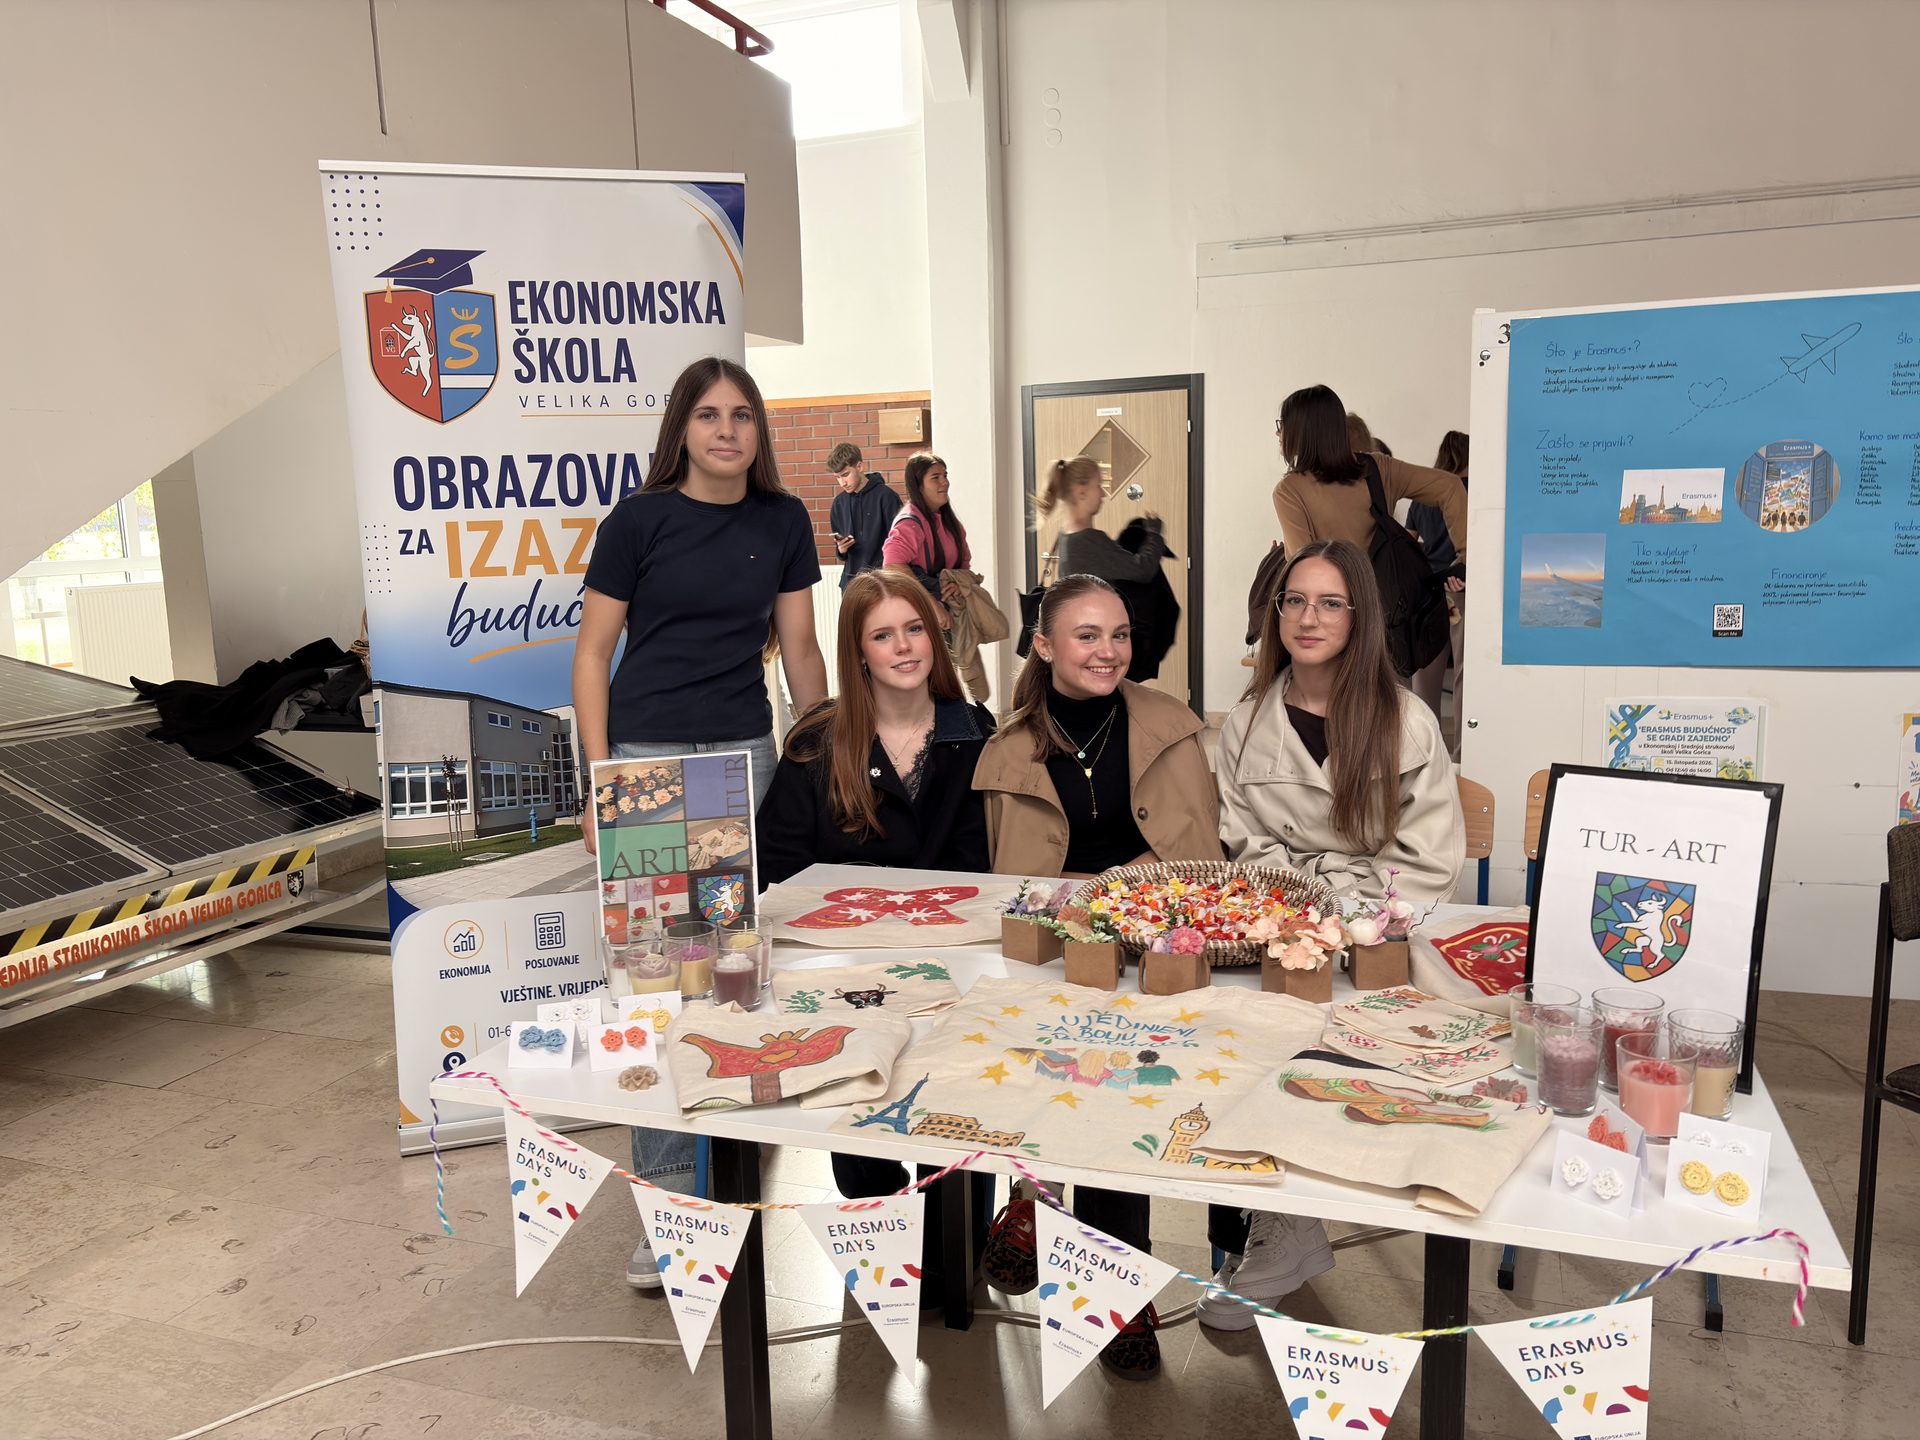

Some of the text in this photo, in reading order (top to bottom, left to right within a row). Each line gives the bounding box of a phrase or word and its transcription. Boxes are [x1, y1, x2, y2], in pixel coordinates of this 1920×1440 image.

[508, 281, 726, 325] EKONOMSKA
[512, 328, 637, 384] ŠKOLA
[518, 395, 610, 408] VELIKA
[1535, 429, 1575, 450] Zašto
[393, 453, 656, 511] OBRAZOVA
[398, 529, 435, 556] ZA
[1673, 713, 1714, 721] Erasmus+
[1683, 725, 1737, 734] BUDUĆNOST
[1646, 734, 1658, 742] SE
[1659, 734, 1686, 742] GRADI
[725, 755, 749, 817] TUR
[1579, 827, 1640, 855] TUR
[1661, 839, 1727, 865] ART
[601, 846, 689, 882] ART
[53, 925, 141, 971] STRUKOVNA
[144, 914, 188, 941] ŠKOLA
[190, 895, 233, 926] VELIKA
[236, 880, 282, 911] GORICA
[439, 964, 491, 980] EKONOMIJA
[525, 955, 580, 970] POSLOVANJE
[500, 985, 556, 1004] VJEŠTINE.
[516, 1153, 553, 1178] DAYS
[519, 1137, 587, 1180] ERASMUS
[655, 1210, 729, 1236] ERASMUS
[655, 1226, 694, 1244] DAYS
[827, 1218, 907, 1237] ERASMUS
[833, 1239, 876, 1255] DAYS
[1047, 1252, 1095, 1282] DAYS
[1053, 1236, 1141, 1286] ERASMUS
[1288, 1345, 1389, 1374] ERASMUS
[1518, 1332, 1628, 1362] ERASMUS
[1288, 1365, 1341, 1385] DAYS
[1526, 1361, 1585, 1383] DAYS
